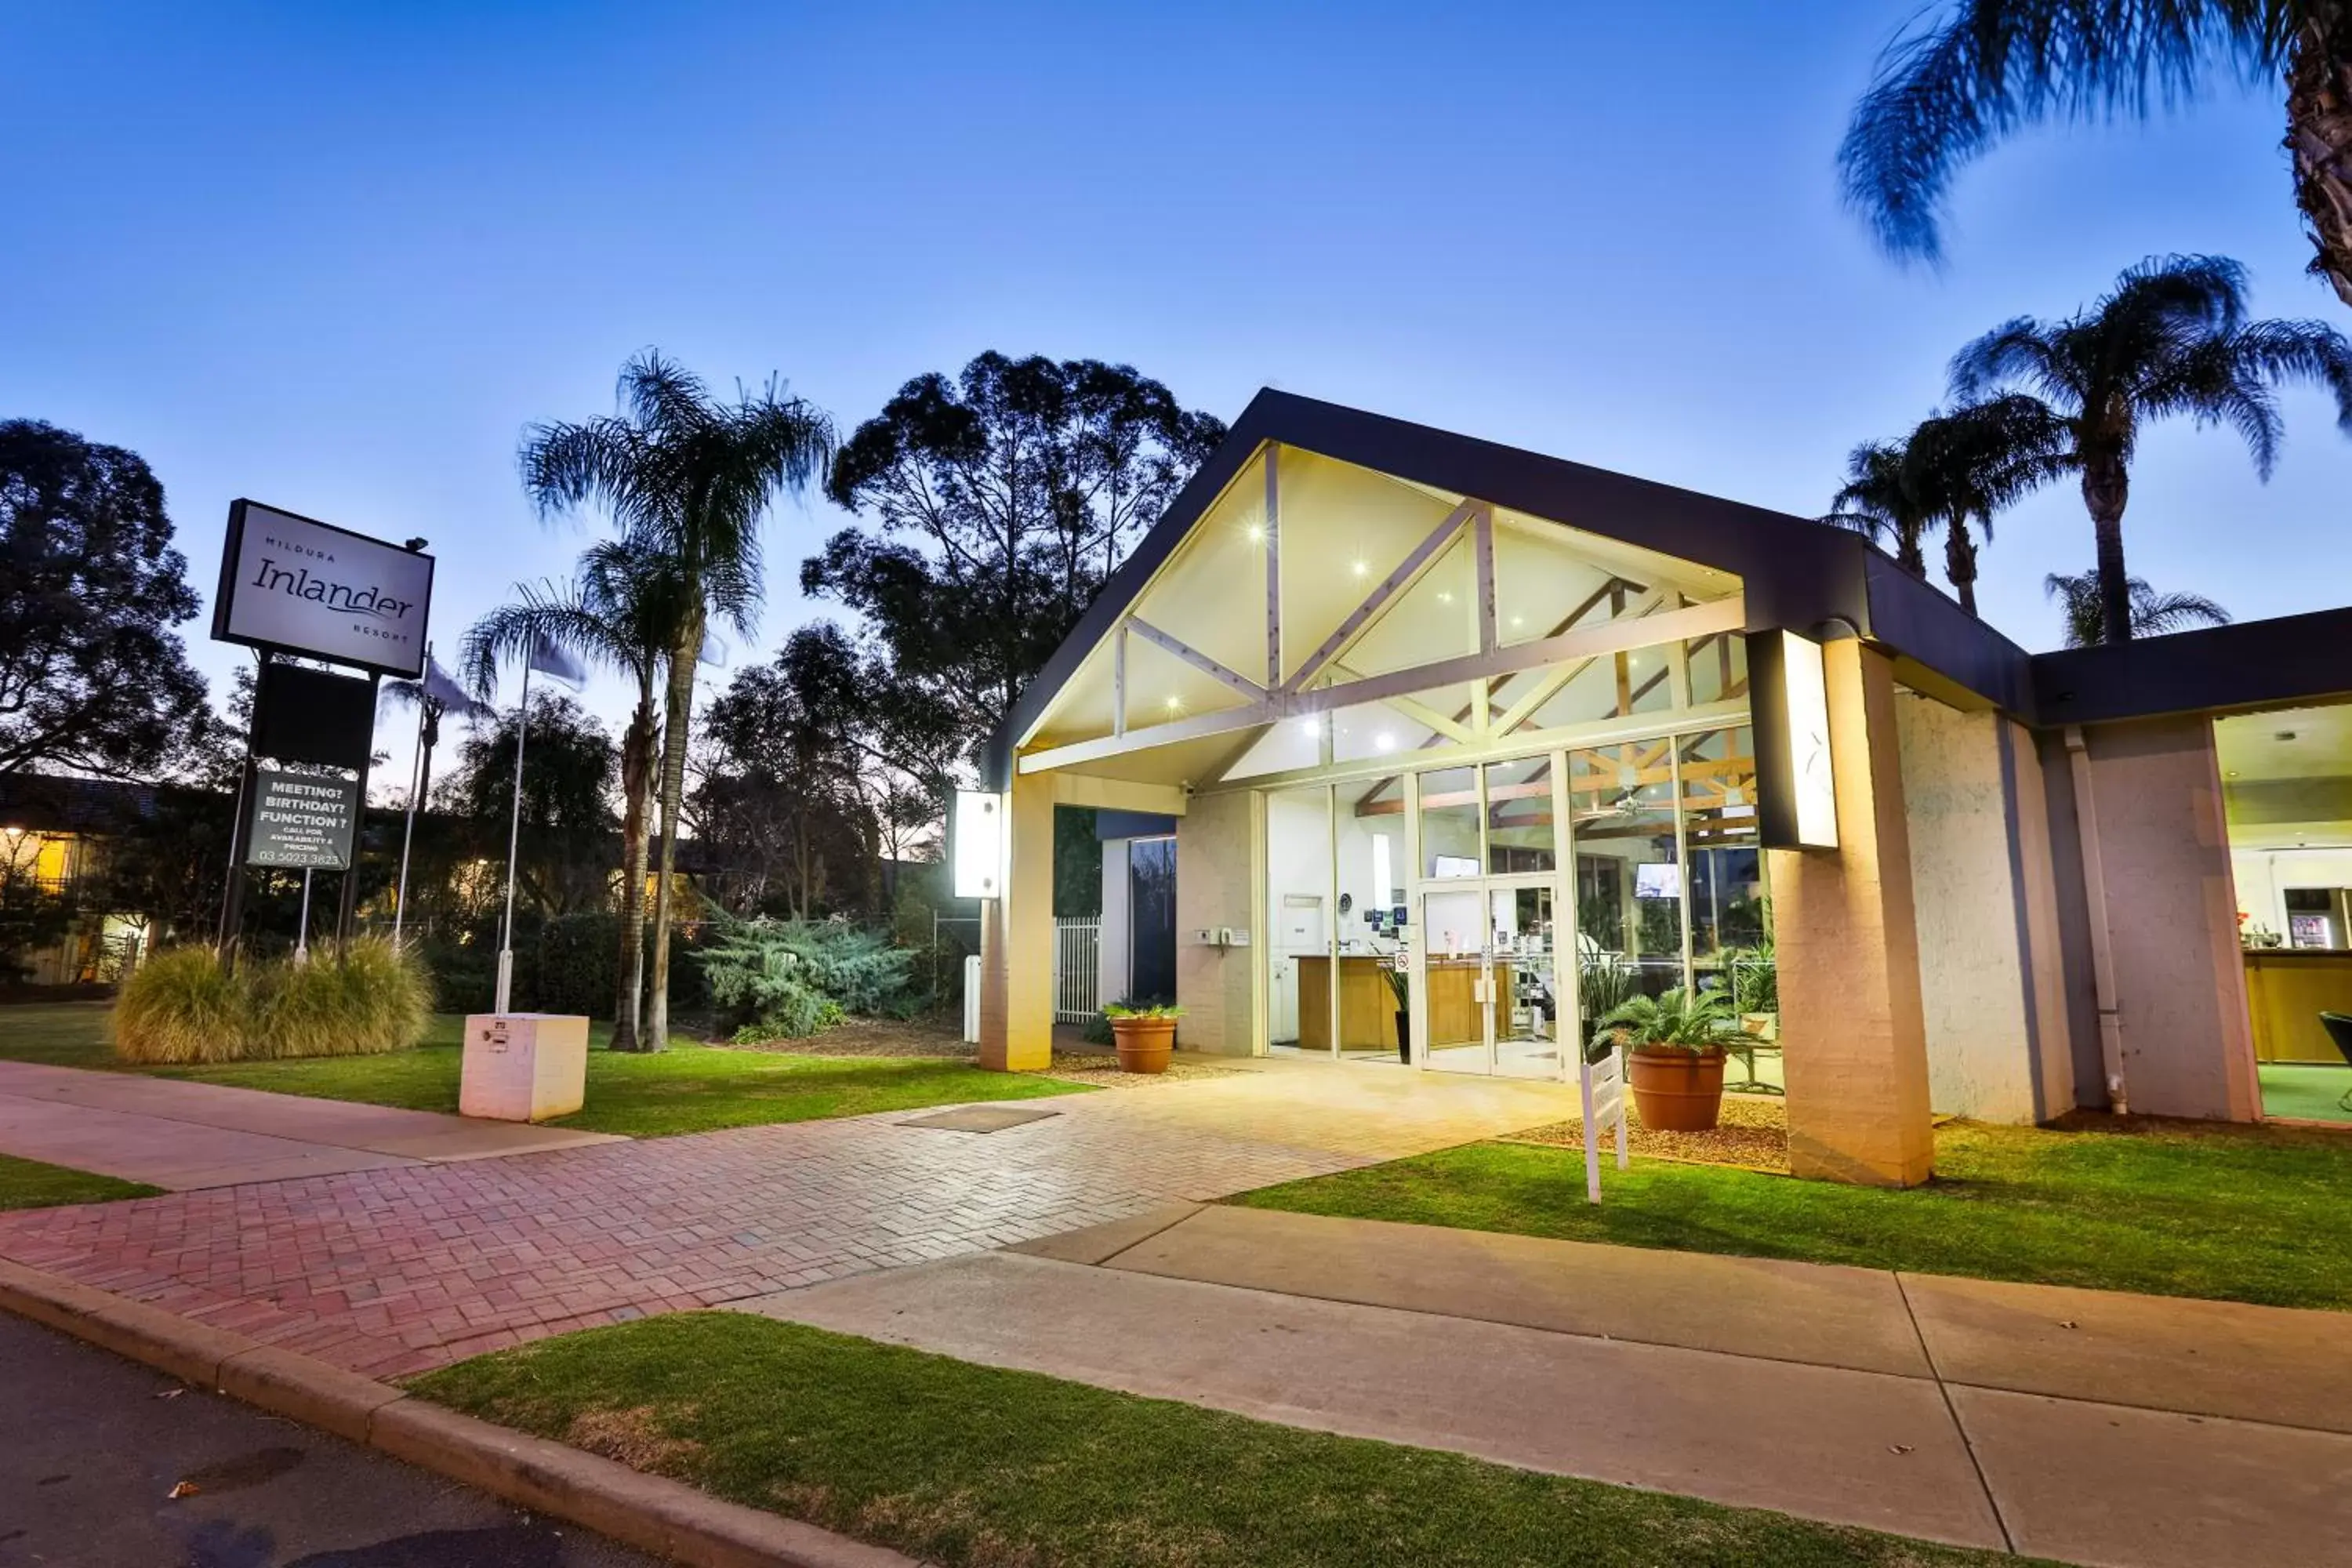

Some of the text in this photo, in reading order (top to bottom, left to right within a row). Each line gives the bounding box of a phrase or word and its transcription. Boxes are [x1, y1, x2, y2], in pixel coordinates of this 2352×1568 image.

[267, 537, 336, 562] MILDURA
[252, 557, 413, 619] Inlander
[354, 625, 408, 643] RESORT
[271, 782, 342, 798] MEETING?
[265, 797, 345, 813] BIRTHDAY?
[260, 851, 275, 861] 03
